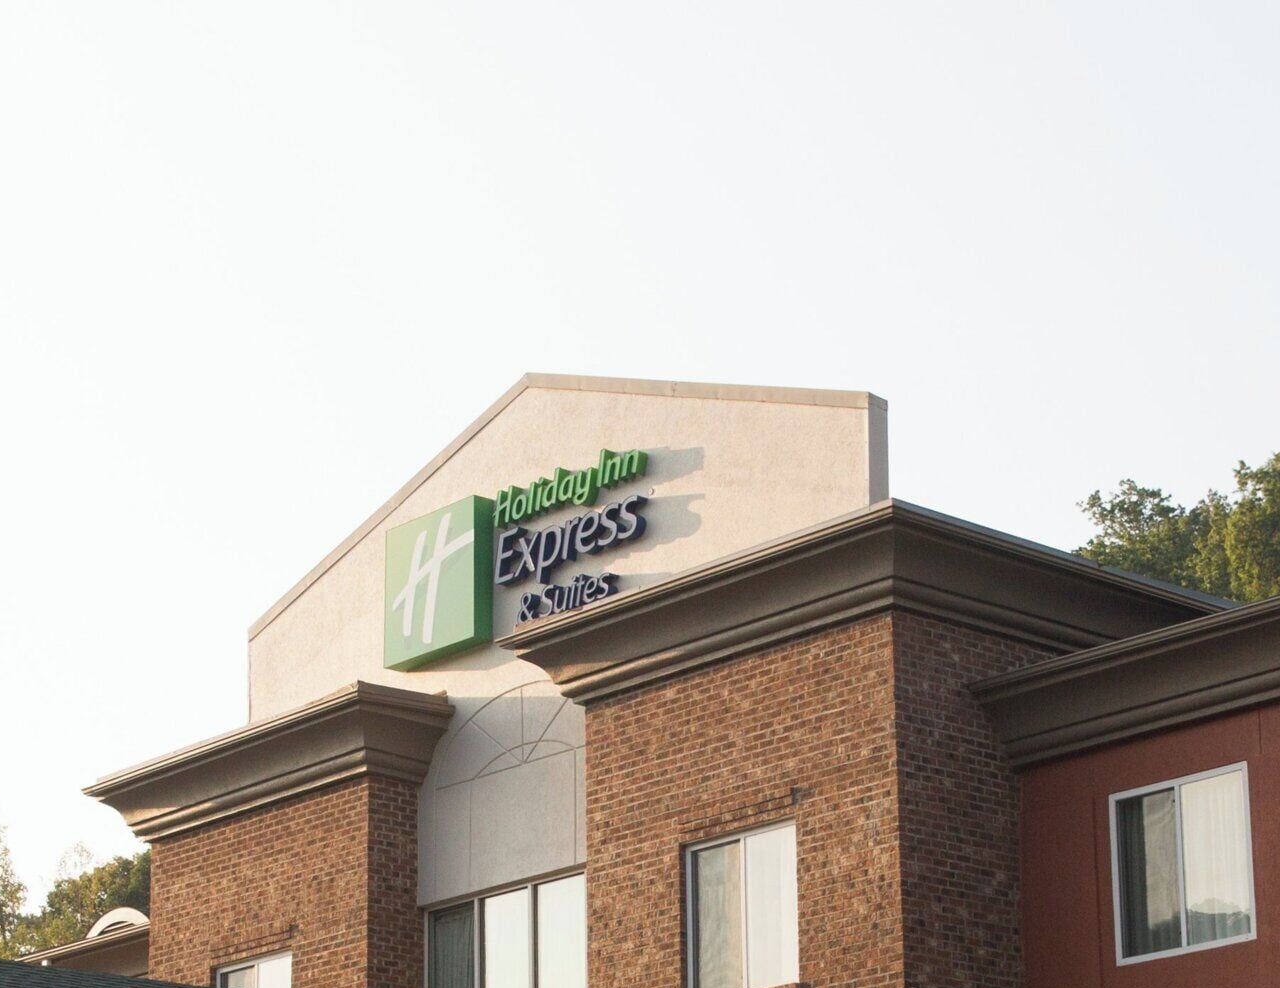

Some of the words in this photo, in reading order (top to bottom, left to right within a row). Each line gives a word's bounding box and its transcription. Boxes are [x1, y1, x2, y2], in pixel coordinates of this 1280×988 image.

[493, 467, 594, 526] Holiday
[596, 448, 648, 488] Inn
[494, 495, 648, 587] Express
[517, 592, 540, 624] &
[539, 573, 617, 617] Suites
